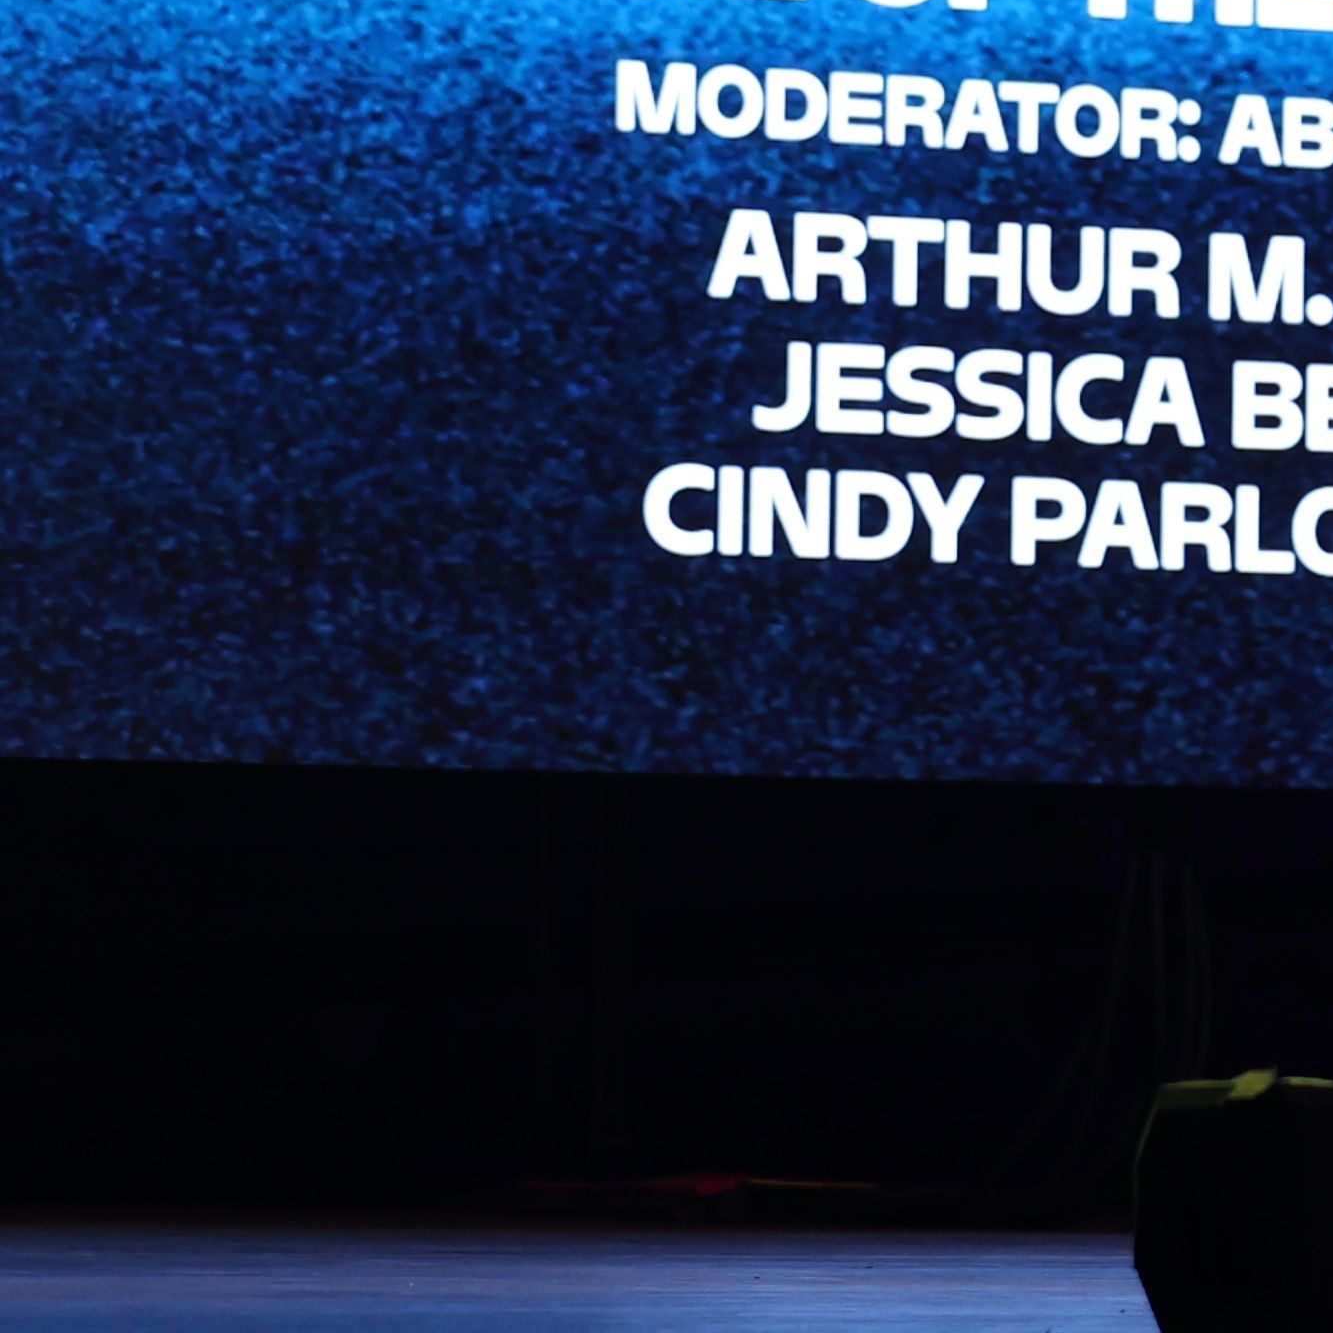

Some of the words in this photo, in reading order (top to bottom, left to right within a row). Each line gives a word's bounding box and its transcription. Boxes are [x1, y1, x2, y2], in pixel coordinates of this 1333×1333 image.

[617, 61, 1201, 165] MODERATOR:
[709, 210, 1181, 318] ARTHUR
[1210, 234, 1333, 325] M.
[754, 343, 1204, 446] JESSICA
[645, 464, 984, 562] CINDY
